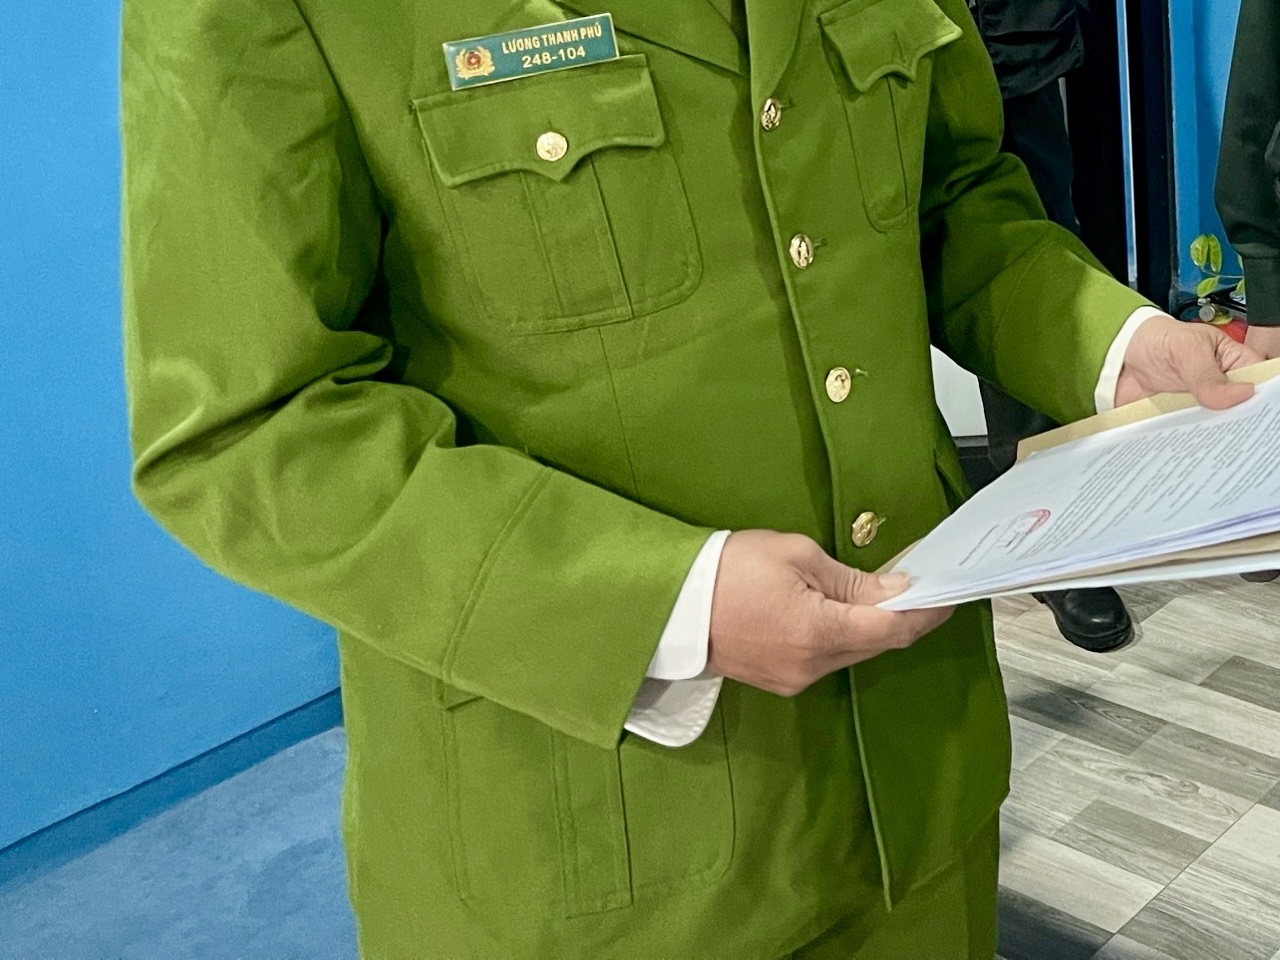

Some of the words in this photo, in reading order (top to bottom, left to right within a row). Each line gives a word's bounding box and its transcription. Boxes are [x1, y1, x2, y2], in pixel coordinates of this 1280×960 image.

[502, 35, 540, 54] LƯƠNG
[541, 29, 579, 47] THANH
[580, 22, 602, 39] PHÚ
[522, 46, 586, 68] 248-104
